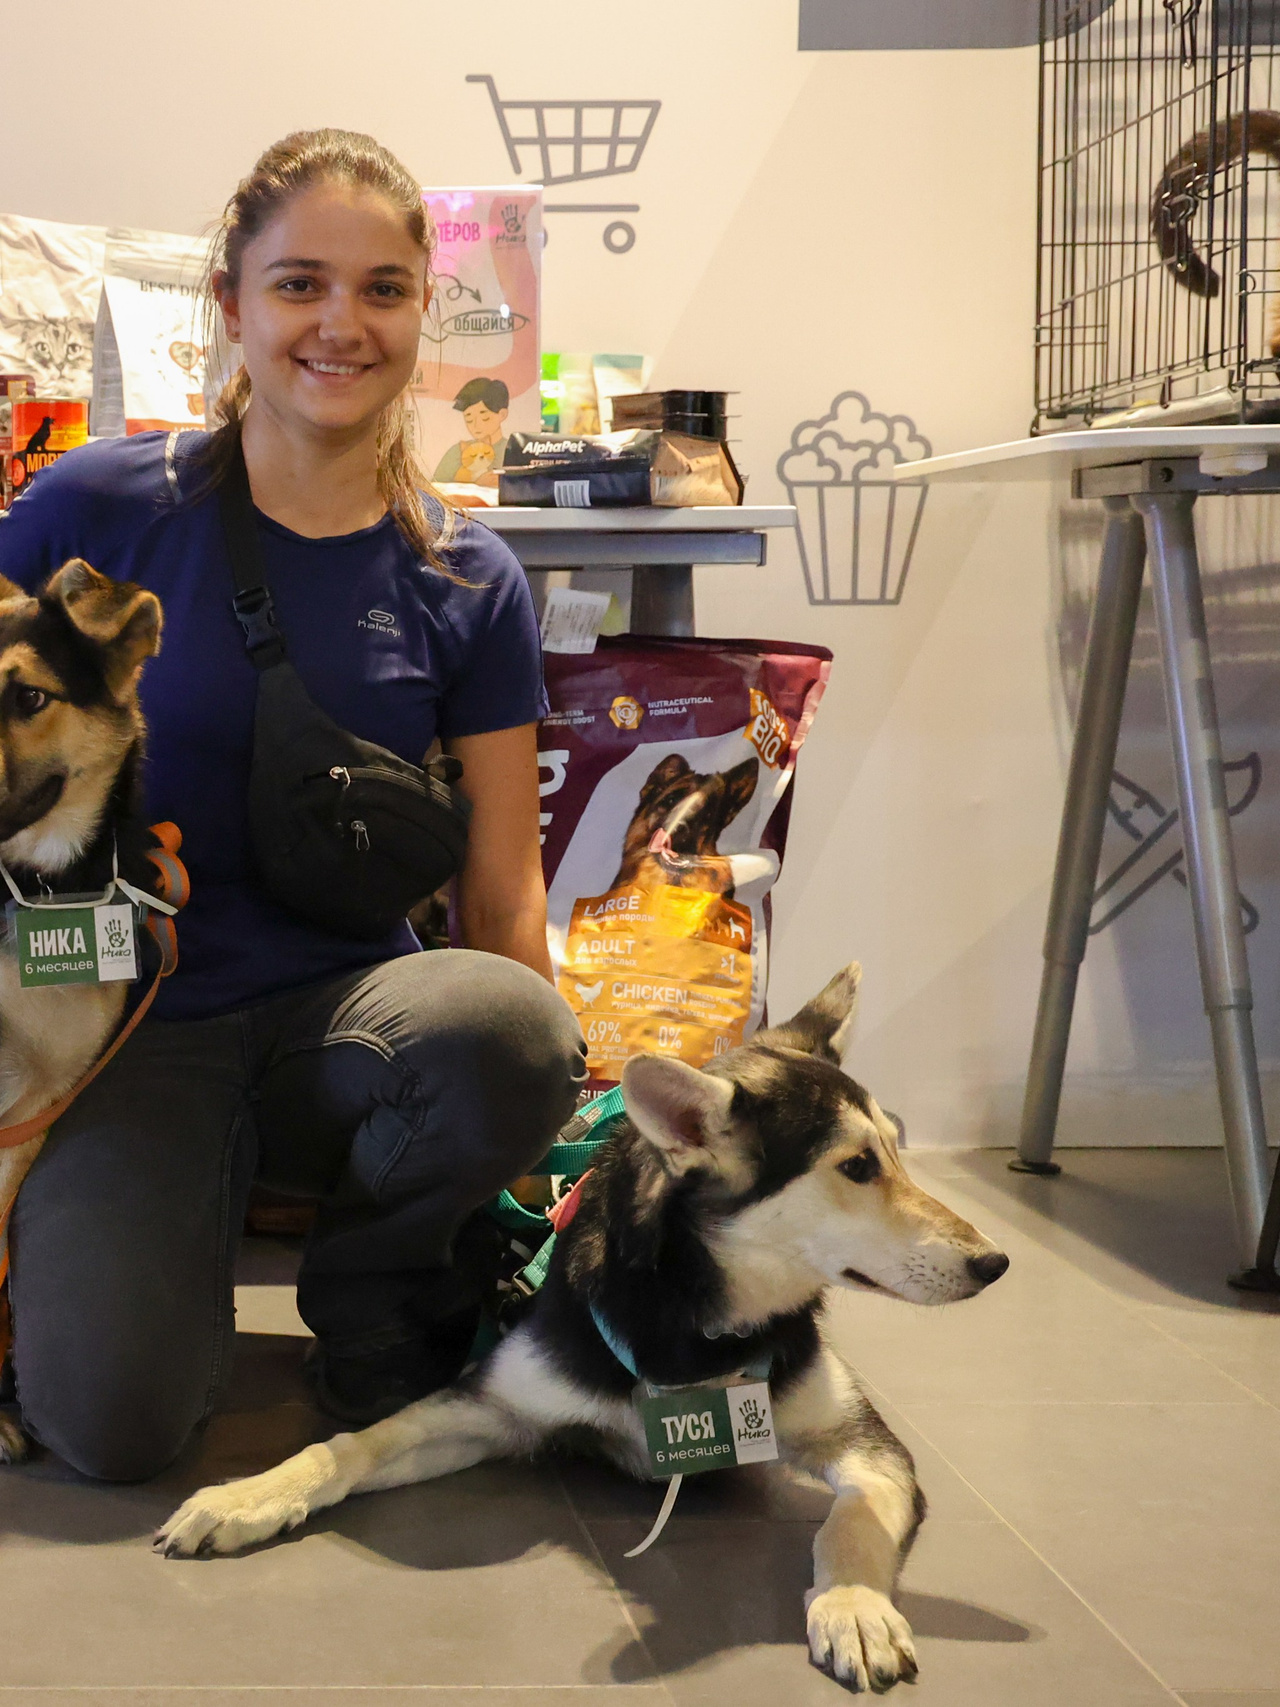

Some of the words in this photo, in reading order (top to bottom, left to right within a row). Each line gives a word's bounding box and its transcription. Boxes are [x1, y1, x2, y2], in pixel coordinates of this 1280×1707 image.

[139, 279, 177, 294] BEST
[454, 313, 515, 332] общайся
[522, 440, 587, 456] AlphaPet
[647, 696, 714, 709] NUTRACEUTICAL
[648, 705, 688, 717] FORMULA
[752, 713, 781, 764] BIO
[583, 895, 641, 917] LARGE
[28, 927, 87, 958] НИКА
[576, 939, 637, 955] ADULT
[25, 962, 34, 975] 6
[36, 960, 95, 974] месяцев
[611, 982, 689, 1005] CHICKEN
[587, 1020, 622, 1043] 69%
[658, 1026, 682, 1049] 0%
[661, 1410, 716, 1444] ТУСЯ
[656, 1450, 666, 1462] 6
[668, 1443, 731, 1461] месяцев
